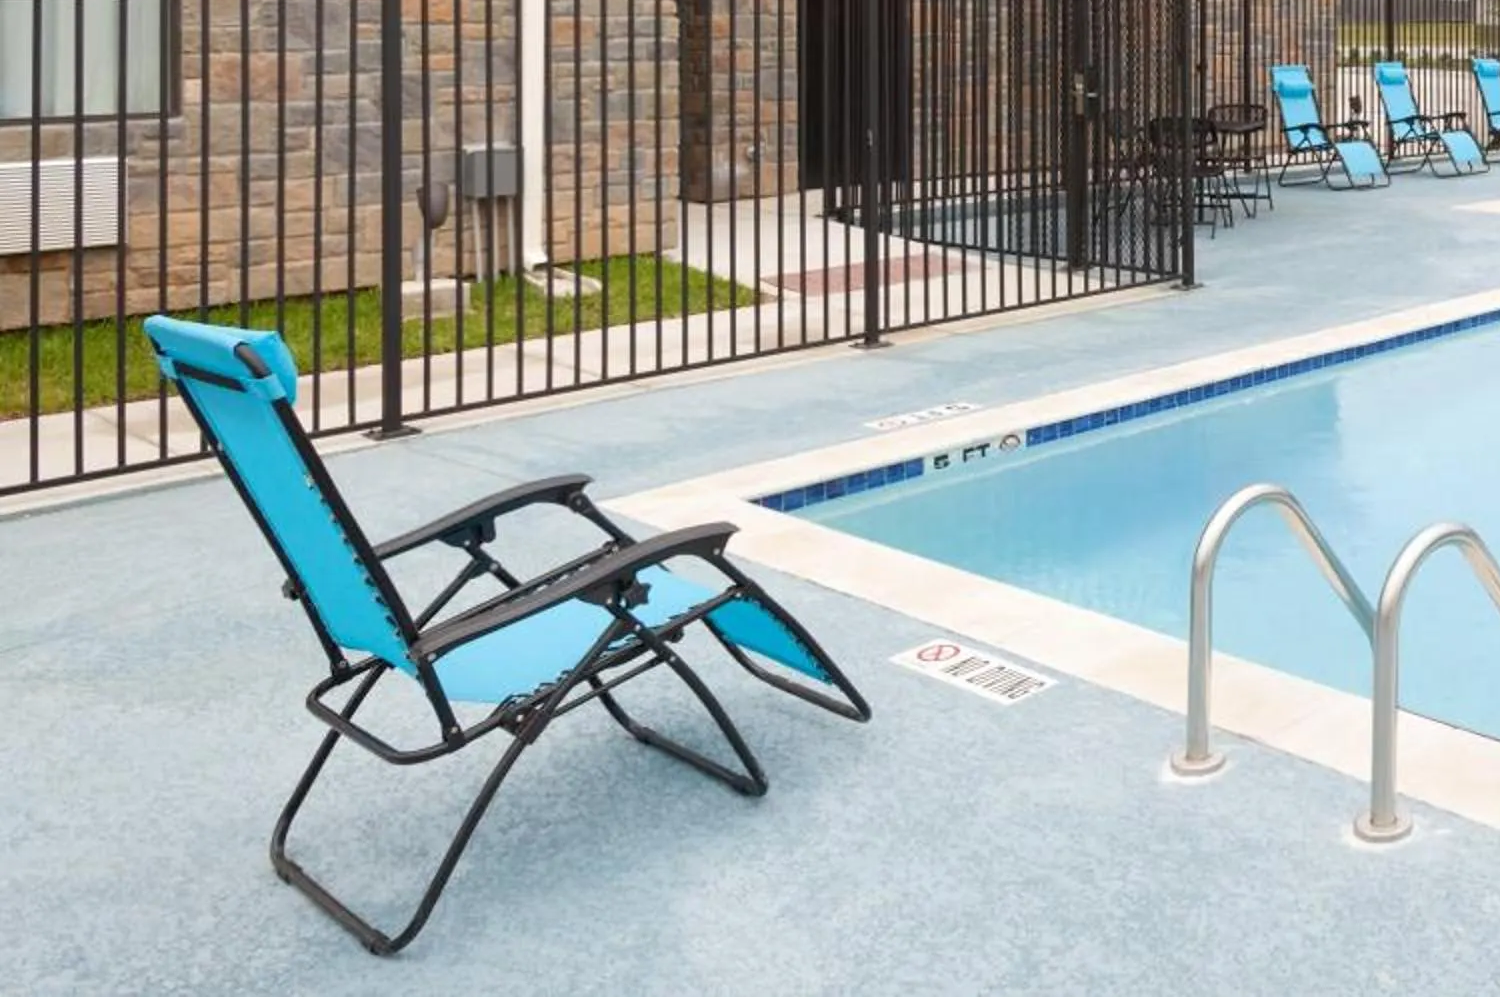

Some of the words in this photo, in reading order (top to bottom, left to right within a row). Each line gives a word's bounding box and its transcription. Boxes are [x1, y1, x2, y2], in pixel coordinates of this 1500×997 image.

[932, 454, 950, 470] 5
[962, 443, 991, 463] FT
[943, 656, 990, 677] NO
[966, 666, 1046, 699] DIVING
